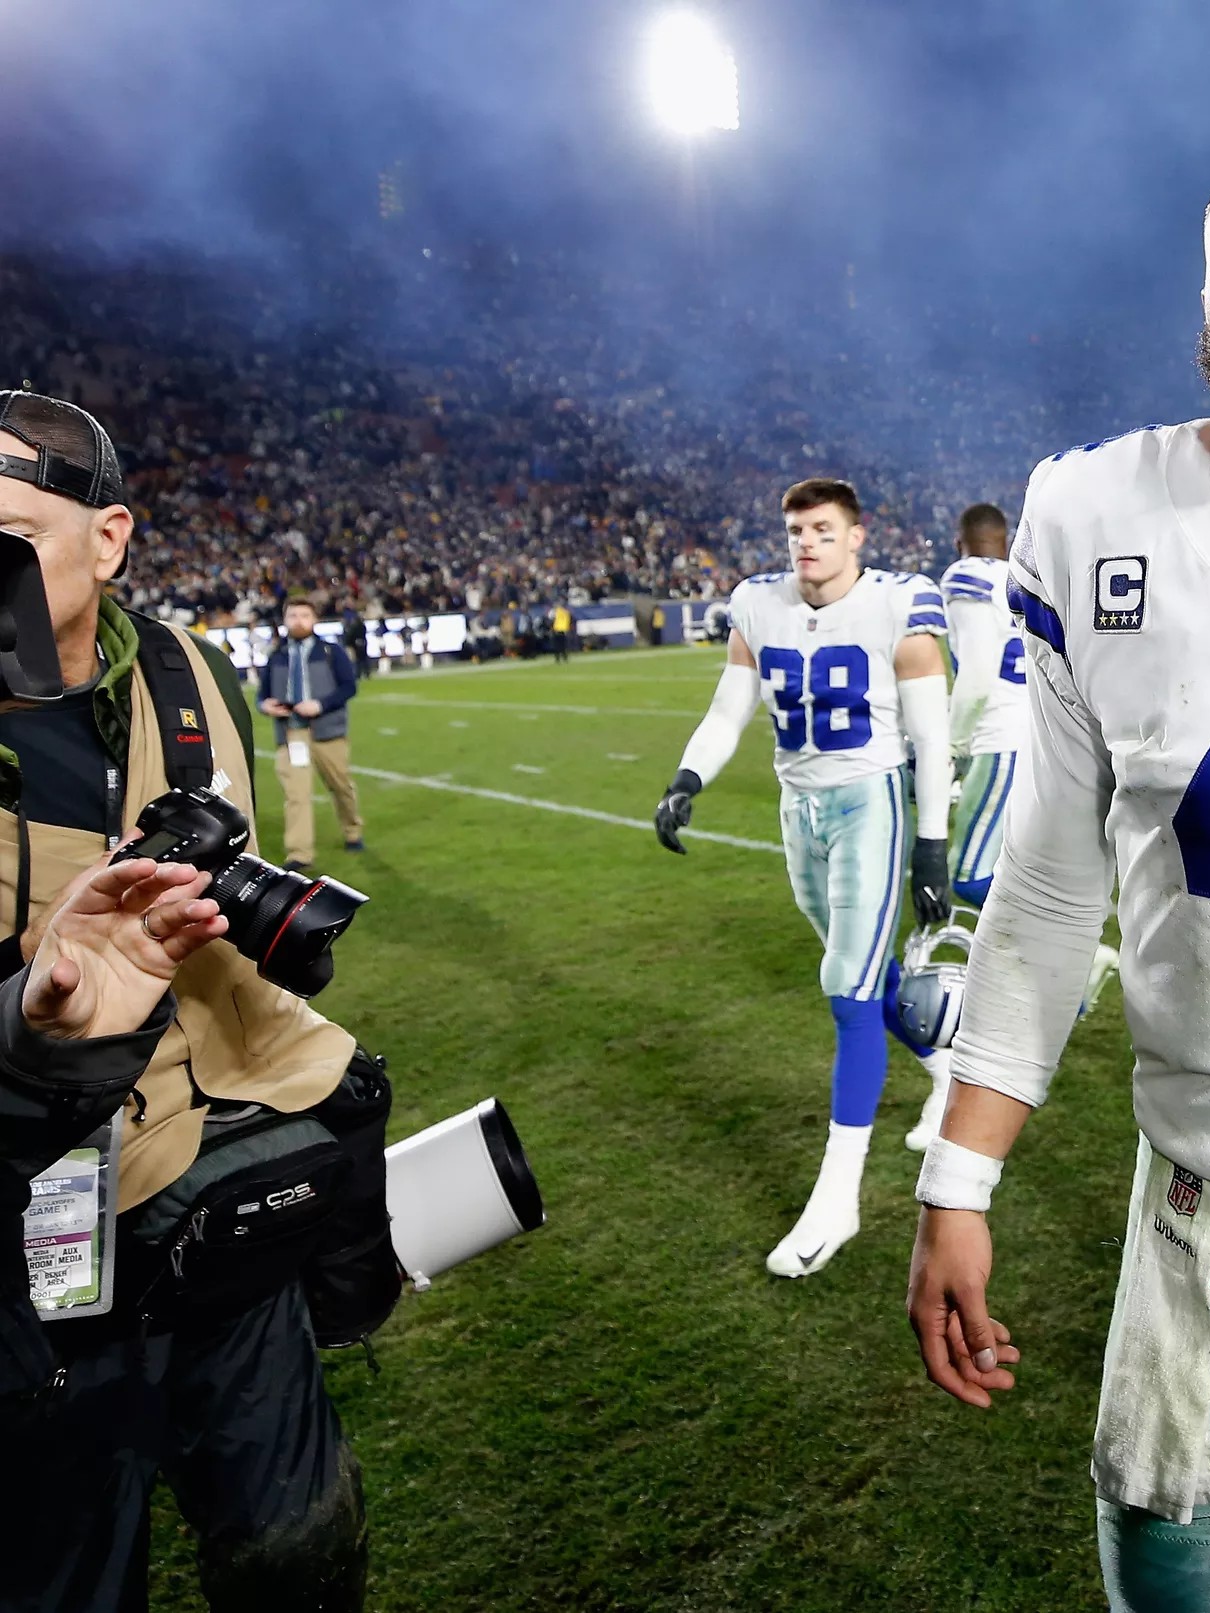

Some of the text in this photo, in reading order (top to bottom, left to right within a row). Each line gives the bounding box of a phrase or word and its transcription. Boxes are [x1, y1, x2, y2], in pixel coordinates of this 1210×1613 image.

[1099, 559, 1143, 612] C
[759, 645, 872, 751] 38
[177, 734, 204, 743] Canon
[229, 831, 247, 846] Canon
[1170, 1180, 1196, 1213] NFL
[29, 1205, 60, 1216] GAME
[1154, 1213, 1195, 1258] Wilson
[25, 1237, 57, 1247] MEDIA
[62, 1247, 78, 1256] AUX
[58, 1254, 83, 1264] MEDIA
[29, 1260, 53, 1270] ROOM
